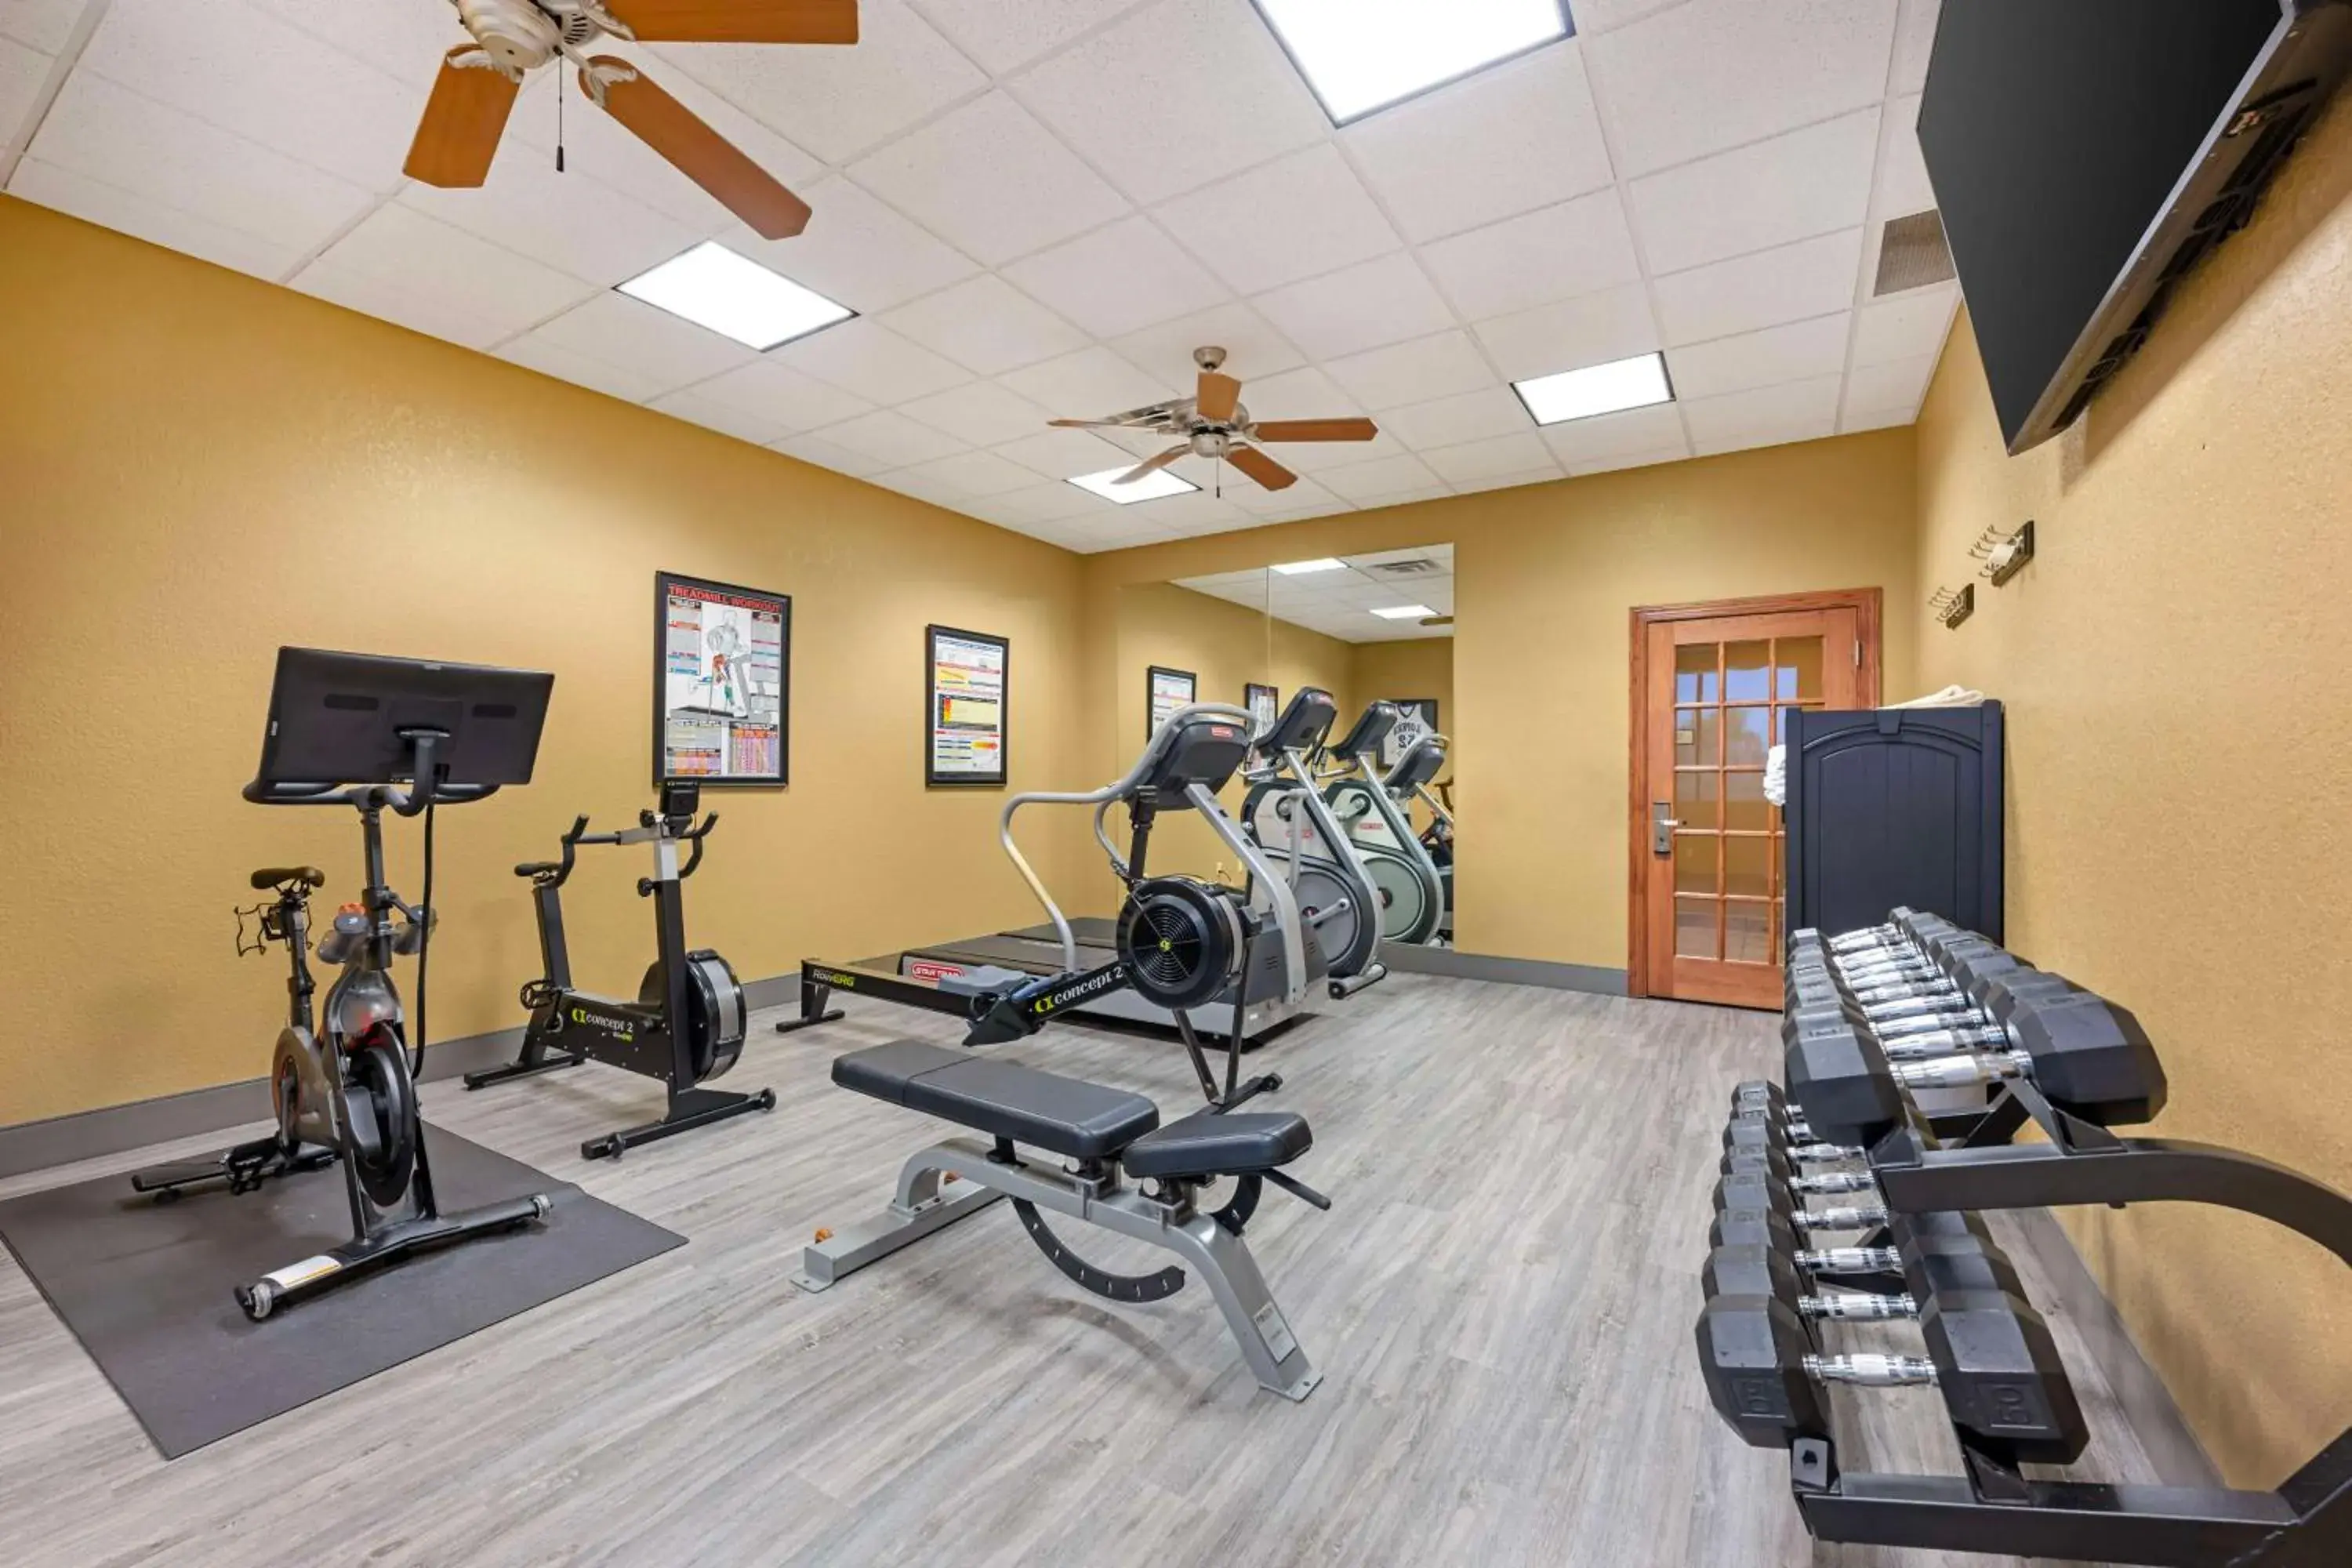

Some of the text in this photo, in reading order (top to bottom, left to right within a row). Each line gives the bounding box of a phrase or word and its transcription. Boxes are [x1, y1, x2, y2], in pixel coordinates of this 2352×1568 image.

[669, 584, 728, 604] TREADMILL
[730, 596, 780, 612] WORKOUT
[915, 967, 936, 978] STAR
[1054, 971, 1112, 1005] concept
[1113, 965, 1123, 979] 2
[586, 1014, 625, 1031] concept
[626, 1022, 634, 1033] 2
